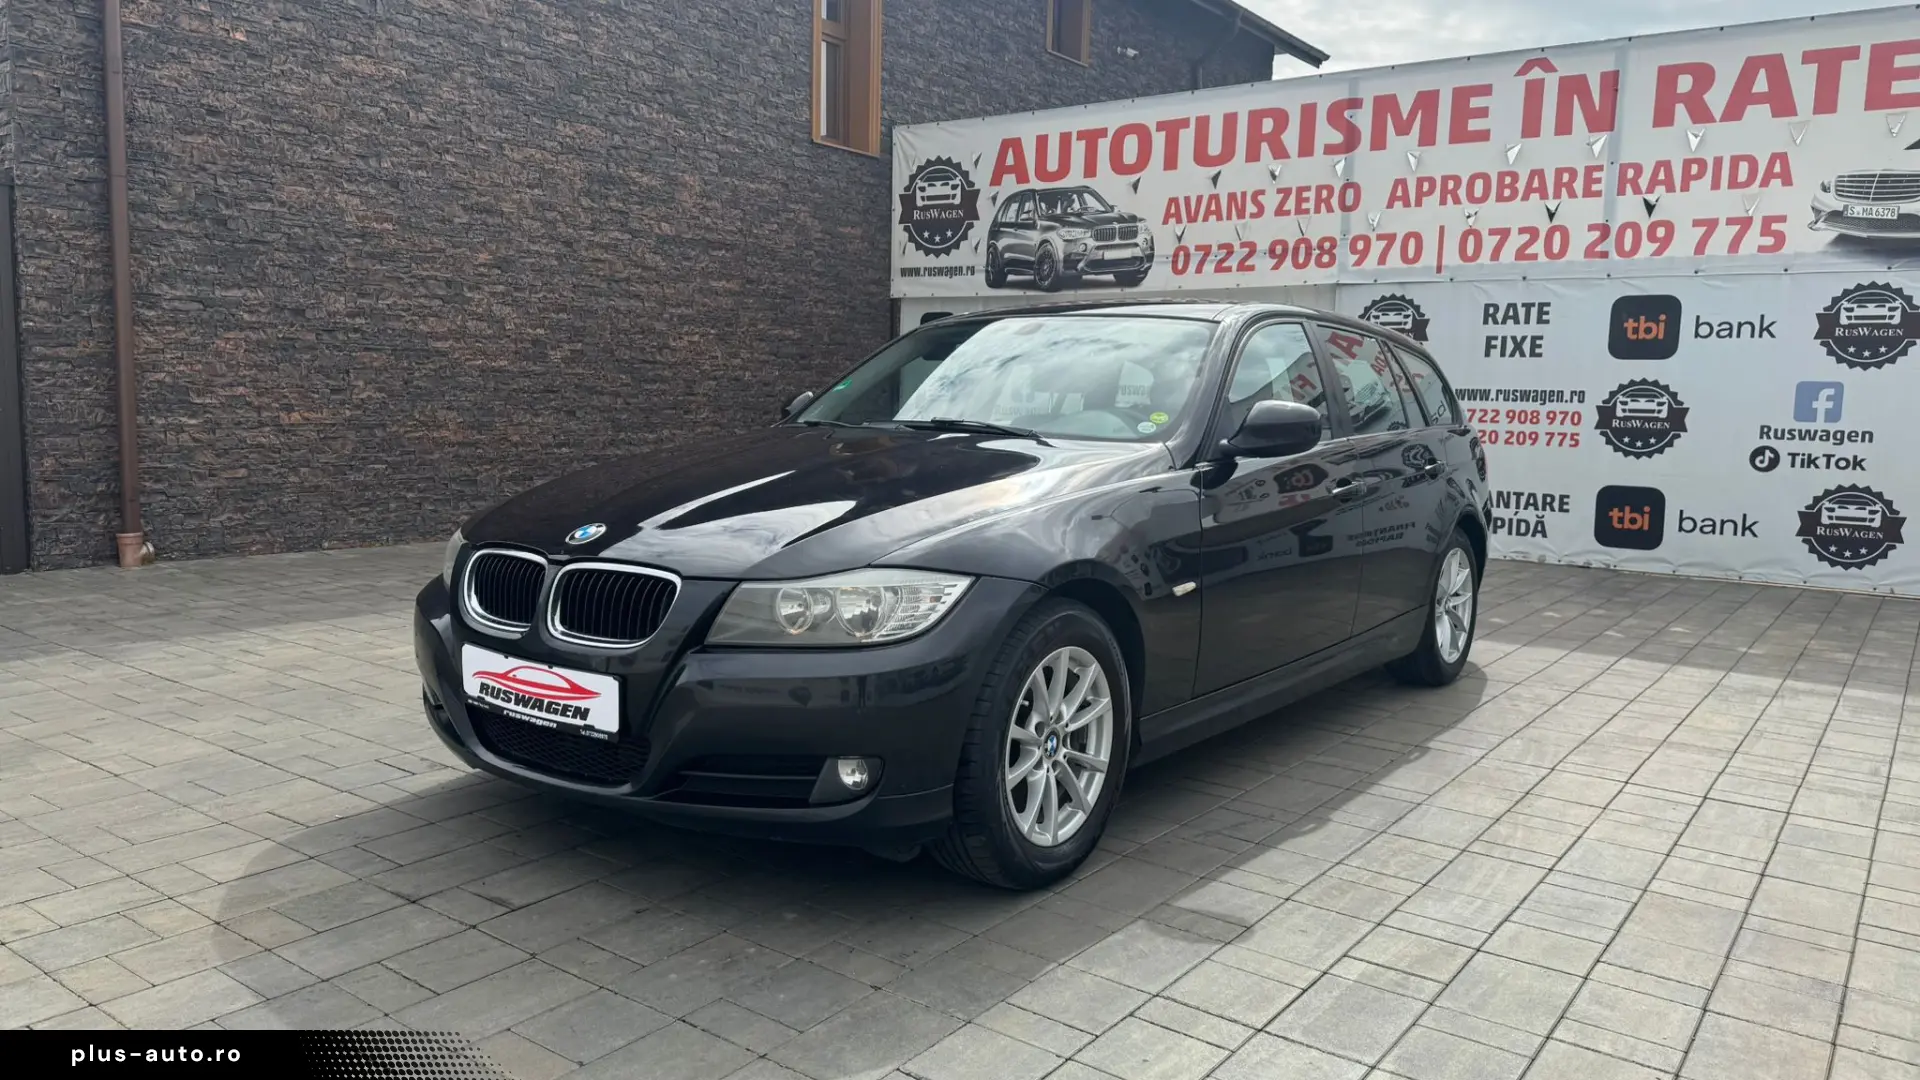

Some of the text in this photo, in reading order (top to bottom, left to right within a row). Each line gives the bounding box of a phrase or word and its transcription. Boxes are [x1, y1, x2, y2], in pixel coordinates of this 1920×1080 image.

[990, 38, 1920, 187] AUTOTURISME ÎN RATE
[1162, 152, 1794, 225] AVANS ZERO APROBARE RAPIDA
[1171, 214, 1788, 276] 0722 908 970 0720 209 775
[900, 265, 976, 279] www.ruswagen.ro
[1482, 302, 1551, 325] RATE
[1624, 314, 1777, 341] tbi bank
[1484, 335, 1544, 358] FIXE
[1455, 388, 1586, 406] www.ruswagen.ro
[1467, 408, 1582, 426] 722 908 970
[1478, 429, 1580, 448] 20 209 775
[1759, 424, 1874, 446] Ruswagen
[1787, 452, 1867, 472] TikTok
[1488, 490, 1571, 517] NȚARE
[1492, 513, 1548, 539] PIDĂ
[1608, 506, 1759, 539] tbi bank
[478, 681, 591, 722] RUSWAGEN
[503, 709, 558, 729] ruswagen
